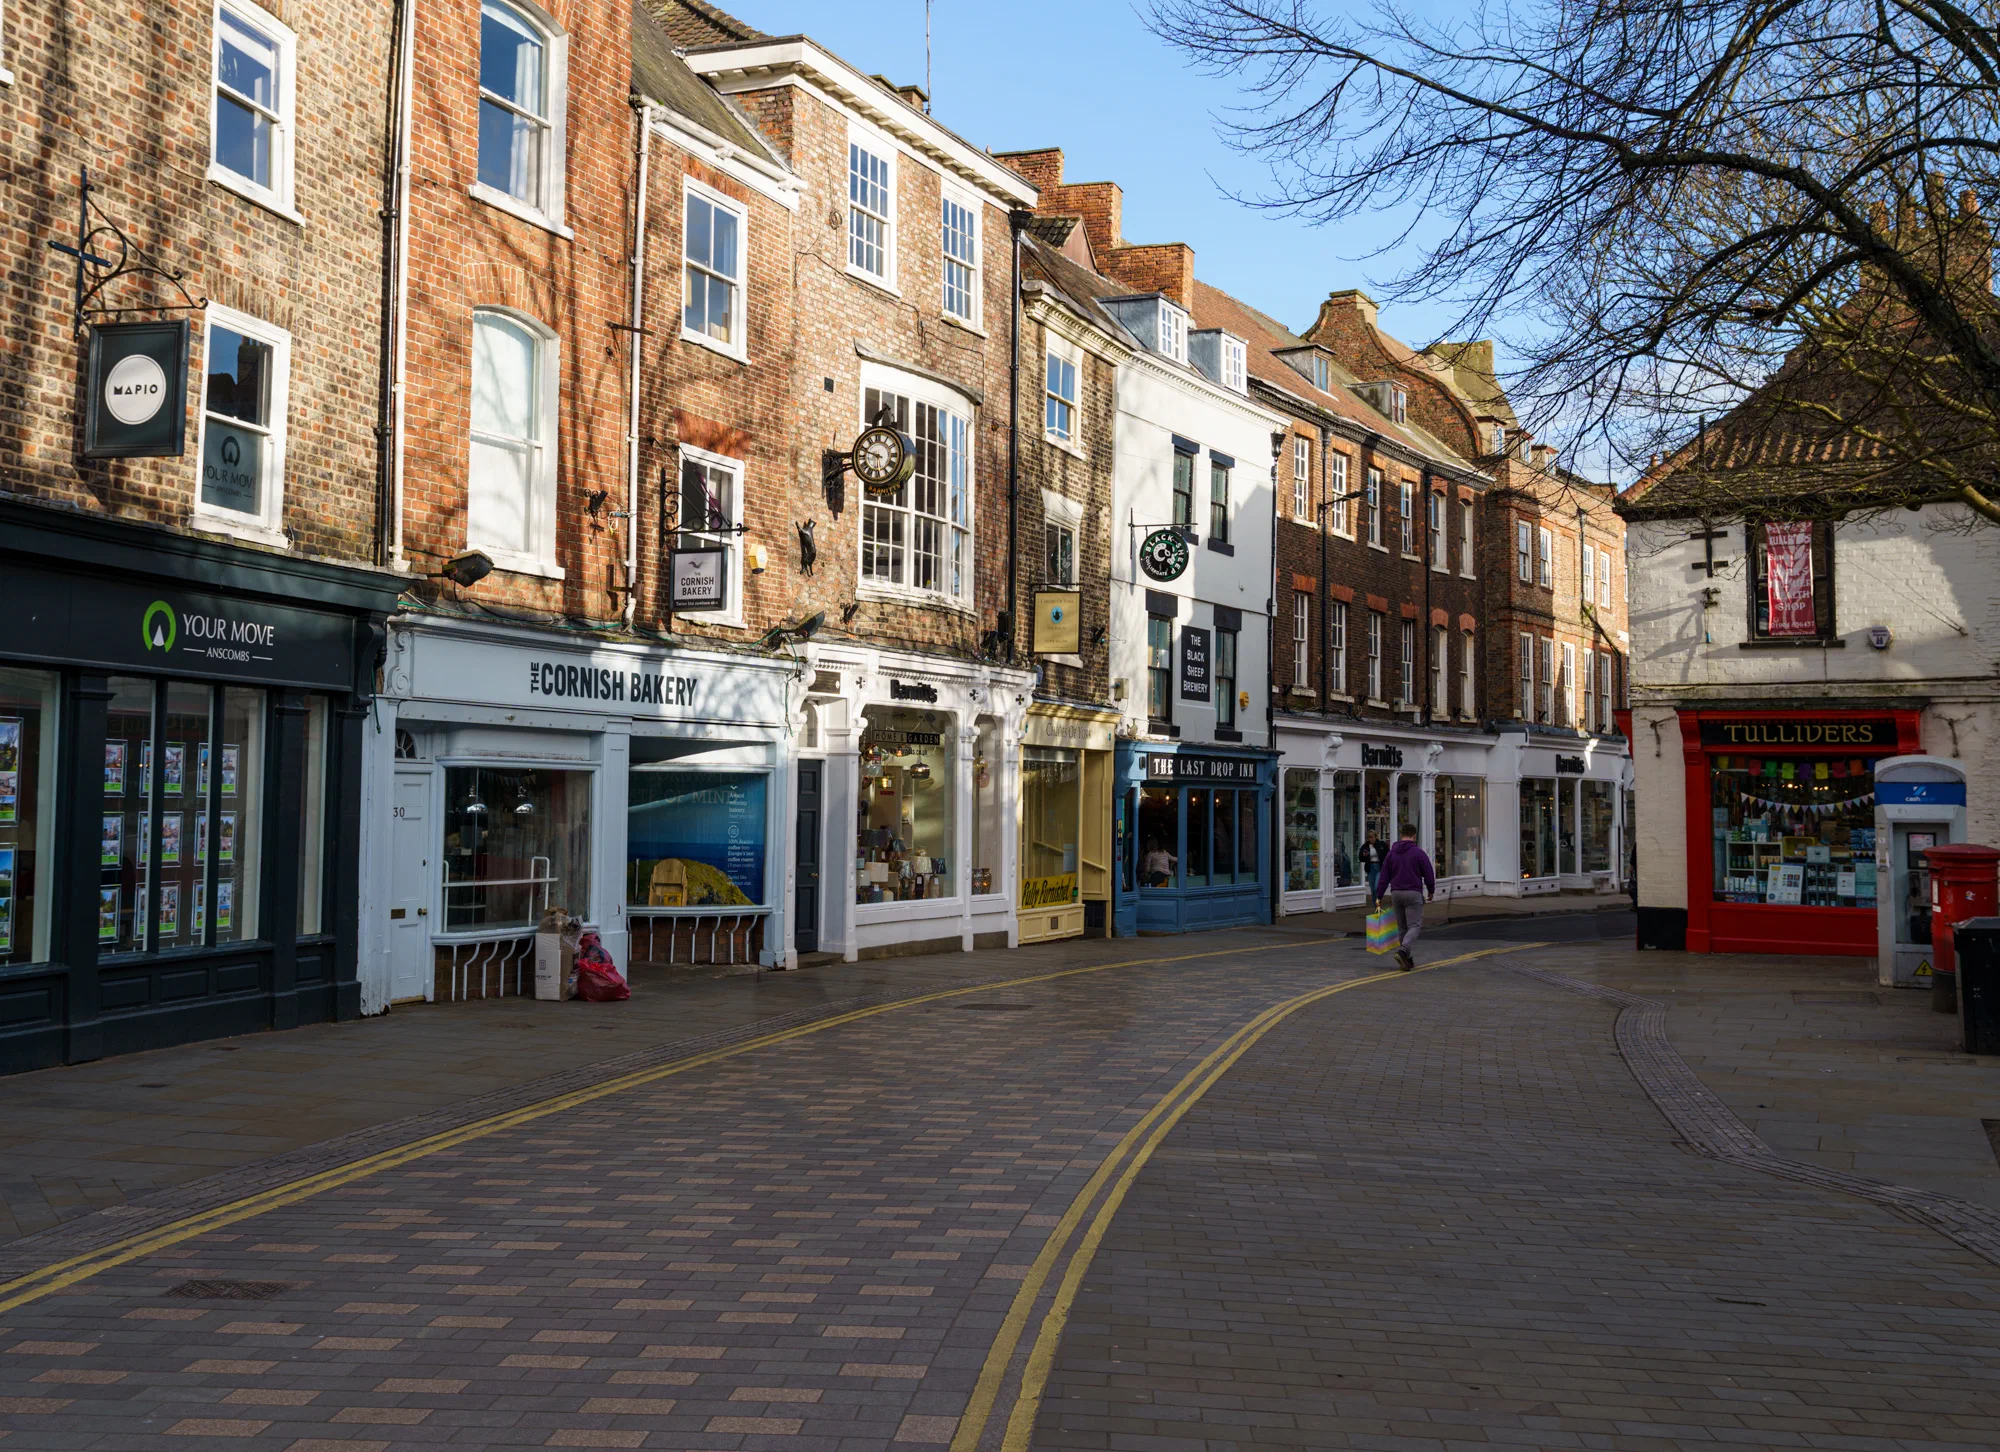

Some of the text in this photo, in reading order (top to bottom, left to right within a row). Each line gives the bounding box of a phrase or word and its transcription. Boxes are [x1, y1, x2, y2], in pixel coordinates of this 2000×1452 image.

[113, 384, 158, 395] MAPIO
[203, 464, 228, 483] YOUR
[1145, 534, 1184, 574] BLACK SHEEP
[680, 577, 714, 586] CORNISH
[682, 587, 712, 596] BAKERY
[1775, 602, 1805, 611] SHOP
[183, 613, 274, 646] YOUR MOVE
[1190, 634, 1202, 646] THE
[206, 647, 250, 662] ANSCOMBS
[1186, 649, 1205, 662] BLACK
[1186, 665, 1204, 678] SHEEP
[530, 662, 697, 706] THE CORNISH BAKERY
[890, 679, 938, 704] Barnitts
[1183, 680, 1208, 693] BREWERY
[876, 731, 897, 741] HOME
[908, 733, 939, 744] GARDEN
[1724, 724, 1873, 742] TULLIVERS
[1362, 743, 1402, 768] Barnitts
[1153, 758, 1254, 777] THE LAST DROP INN
[1556, 754, 1584, 774] Barnitts
[393, 807, 405, 818] 30
[1022, 876, 1072, 908] Fully Furnished
